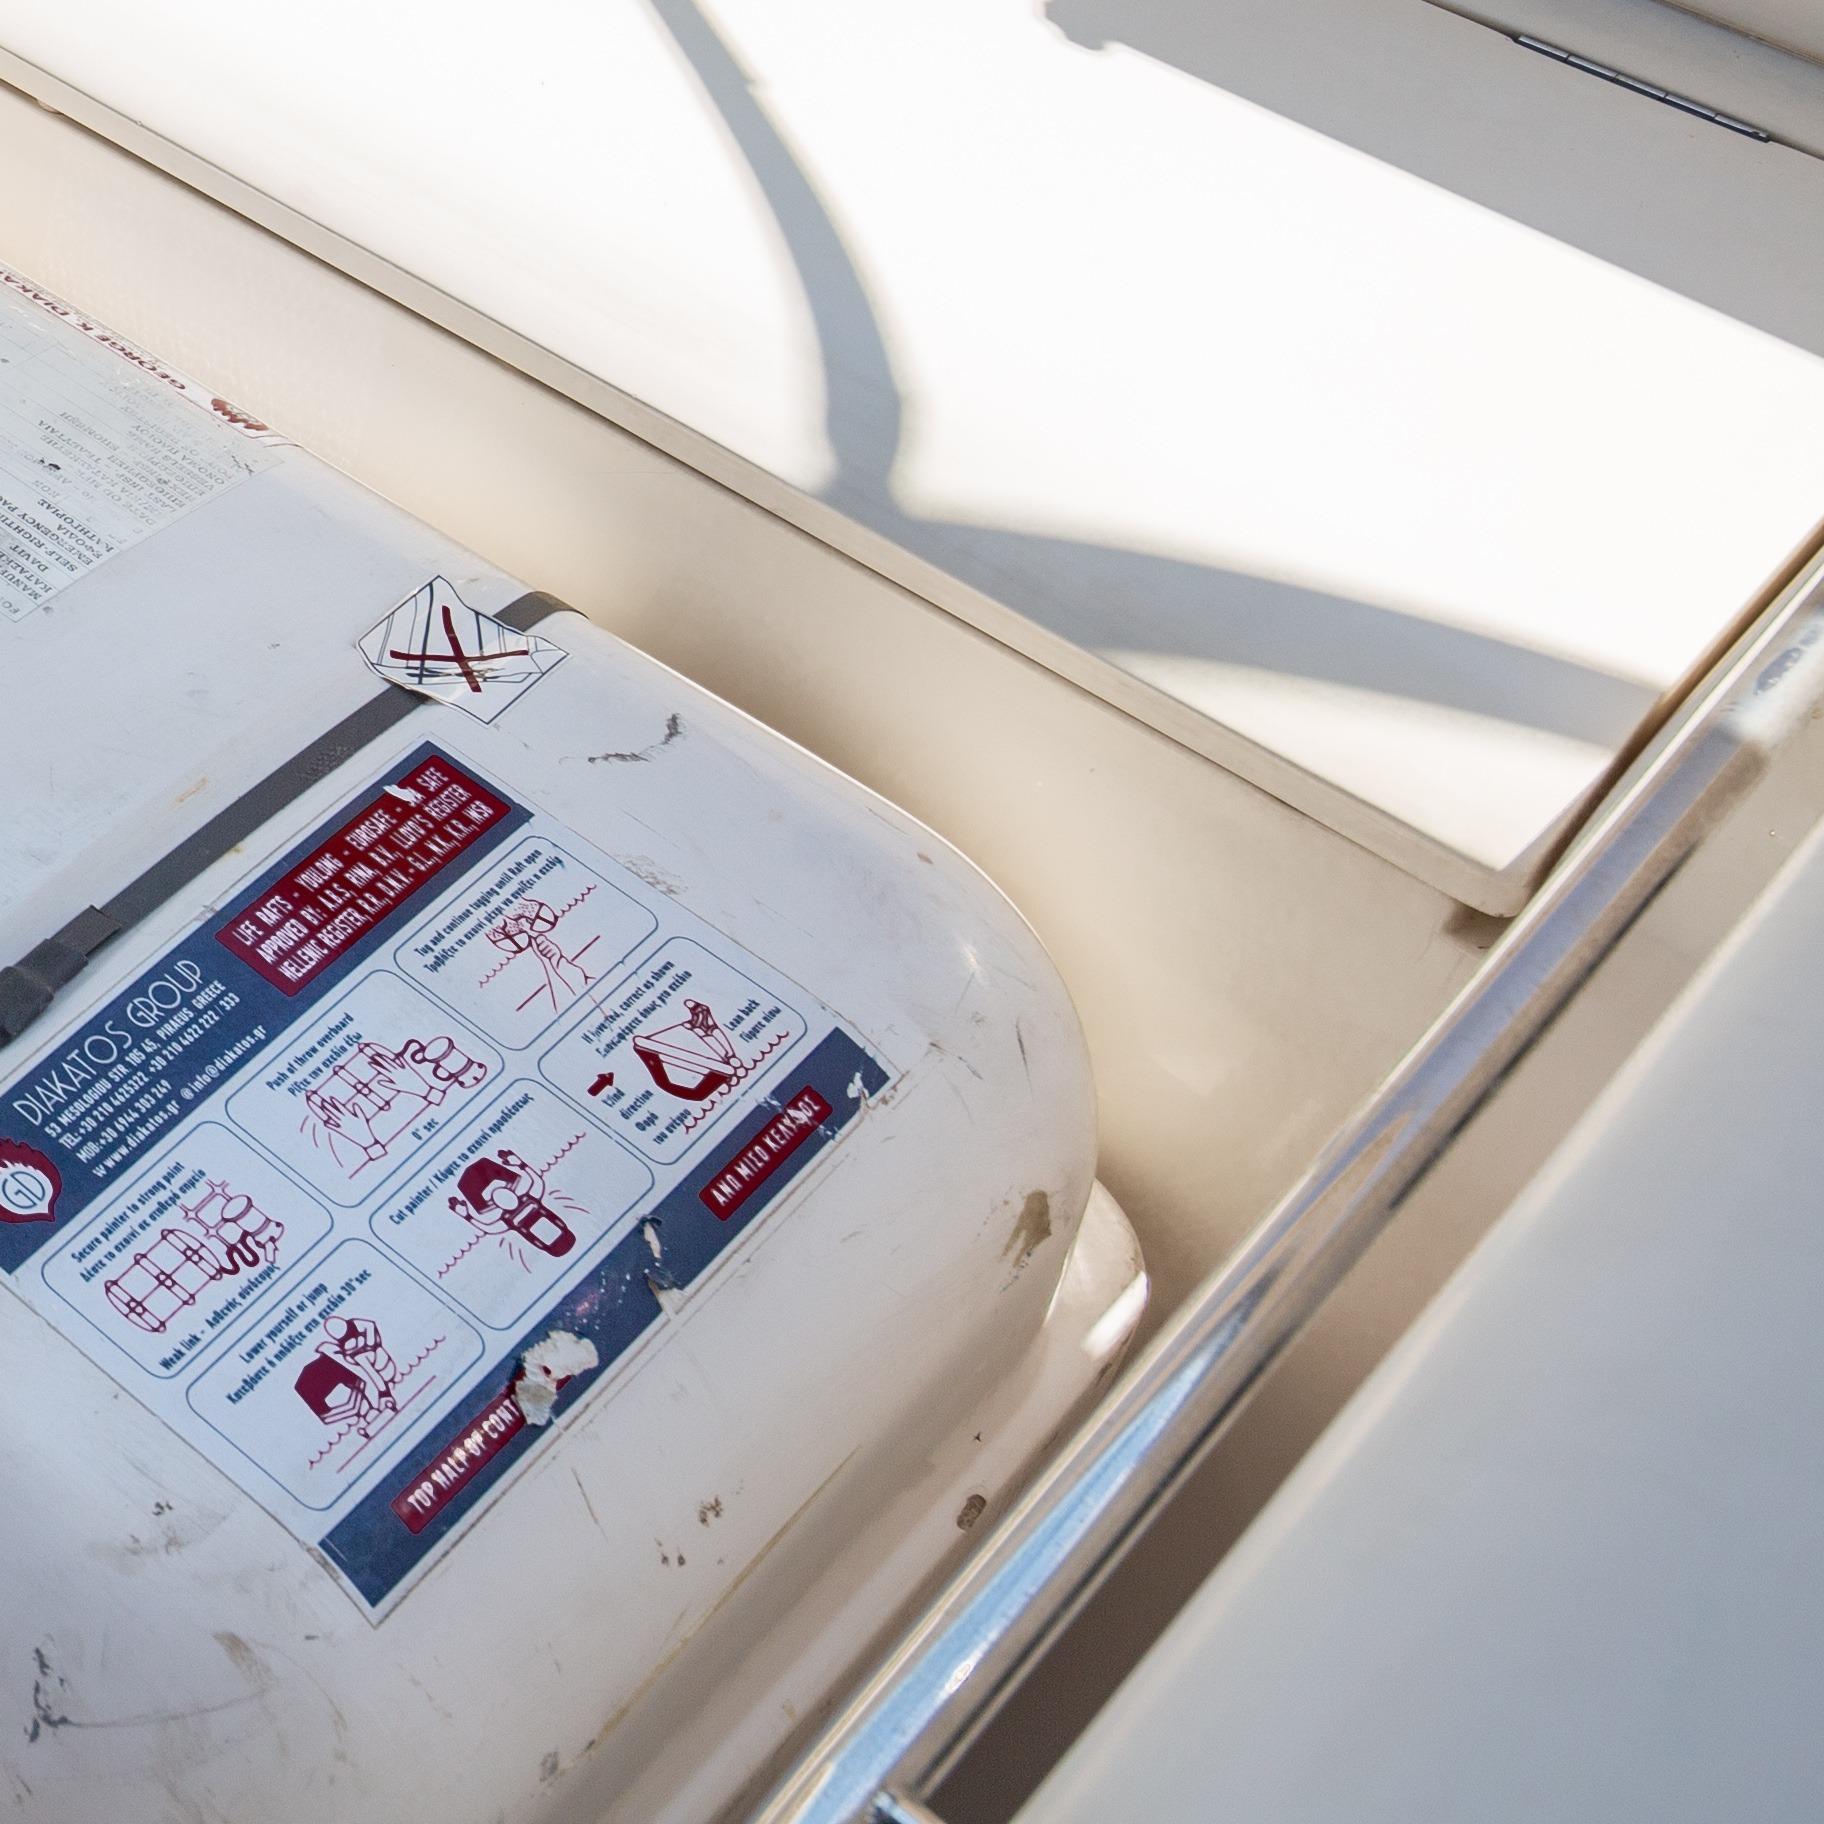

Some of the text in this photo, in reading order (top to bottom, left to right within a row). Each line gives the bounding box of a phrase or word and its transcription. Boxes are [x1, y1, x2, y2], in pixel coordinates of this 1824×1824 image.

[93, 332, 188, 392] GEORGE
[230, 765, 450, 947] LIFE RAFTS YOULONG EUROSAFE SAFE
[253, 916, 311, 965] APPROVED
[298, 902, 329, 927] BY:
[388, 812, 436, 850] LLOYD'S
[422, 781, 472, 822] REGISTER
[412, 847, 545, 959] Tug and continue tugging until Raft open
[276, 937, 330, 983] HELLENIC
[616, 984, 647, 1012] correct
[646, 956, 676, 982] shown
[9, 955, 212, 1126] DIAKATOS GROUP
[721, 995, 761, 1032] Lean back
[42, 1120, 63, 1139] 53
[55, 1076, 114, 1127] MESOLOGIOU
[189, 978, 227, 1010] GREECE
[90, 1100, 115, 1122] 210
[143, 1053, 169, 1075] +30
[160, 1039, 185, 1061] 210
[175, 1022, 205, 1047] 4622
[196, 1008, 221, 1029] 222
[216, 990, 242, 1012] 333
[264, 1068, 290, 1091] Push
[290, 1042, 320, 1067] throw
[311, 1010, 356, 1049] overboard
[98, 1021, 271, 1171] www.diakatos.gr info@diakatos.gr
[111, 1105, 142, 1132] 6944
[131, 1091, 158, 1114] 303
[148, 1077, 174, 1099] 249
[421, 1116, 440, 1133] sec
[617, 1086, 655, 1121] direction
[69, 1159, 188, 1264] Secure painter to strong point
[387, 1207, 409, 1226] Cut
[400, 1182, 437, 1216] painter
[157, 1344, 187, 1372] Weak
[177, 1329, 202, 1352] link
[237, 1278, 331, 1365] Lower yourself or jump
[405, 1478, 443, 1515] TOP
